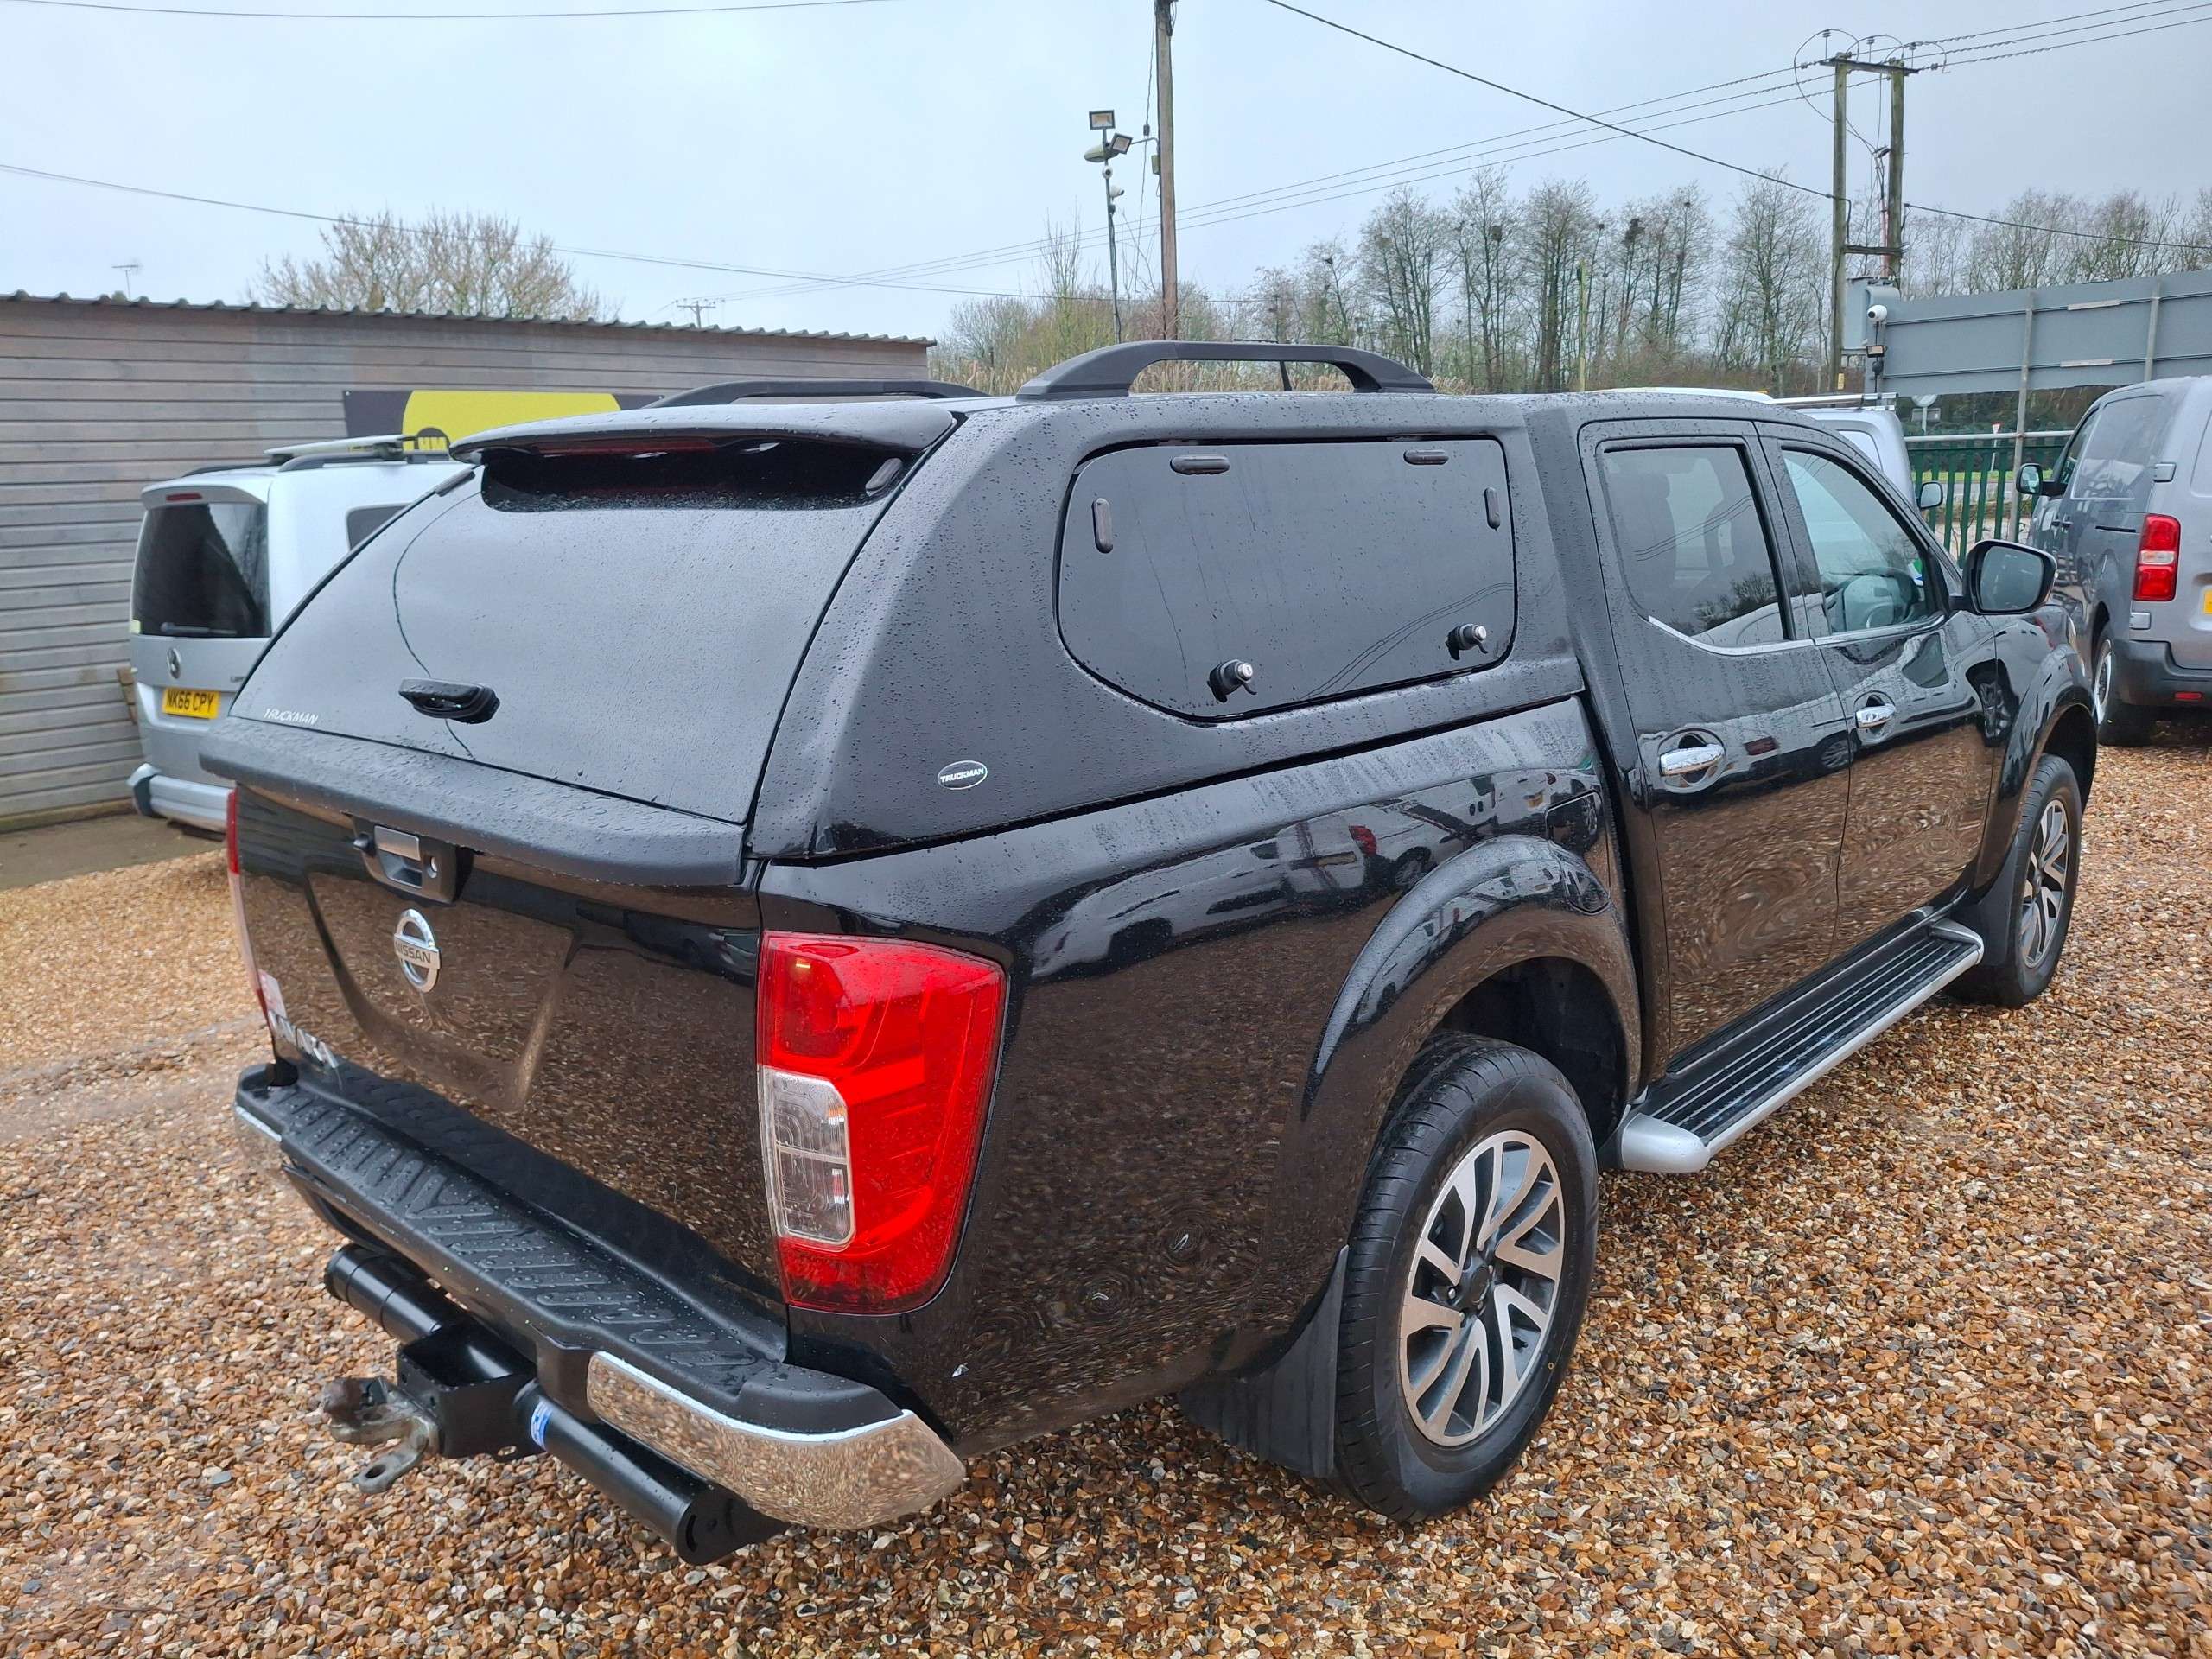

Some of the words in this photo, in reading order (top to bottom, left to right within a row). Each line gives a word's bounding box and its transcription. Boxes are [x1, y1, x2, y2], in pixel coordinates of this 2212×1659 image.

[167, 688, 191, 709] NK66
[192, 692, 215, 713] CPY
[263, 707, 319, 725] TRUCKMAN
[939, 767, 984, 783] TRUCKMAN
[395, 938, 431, 963] NISSAN
